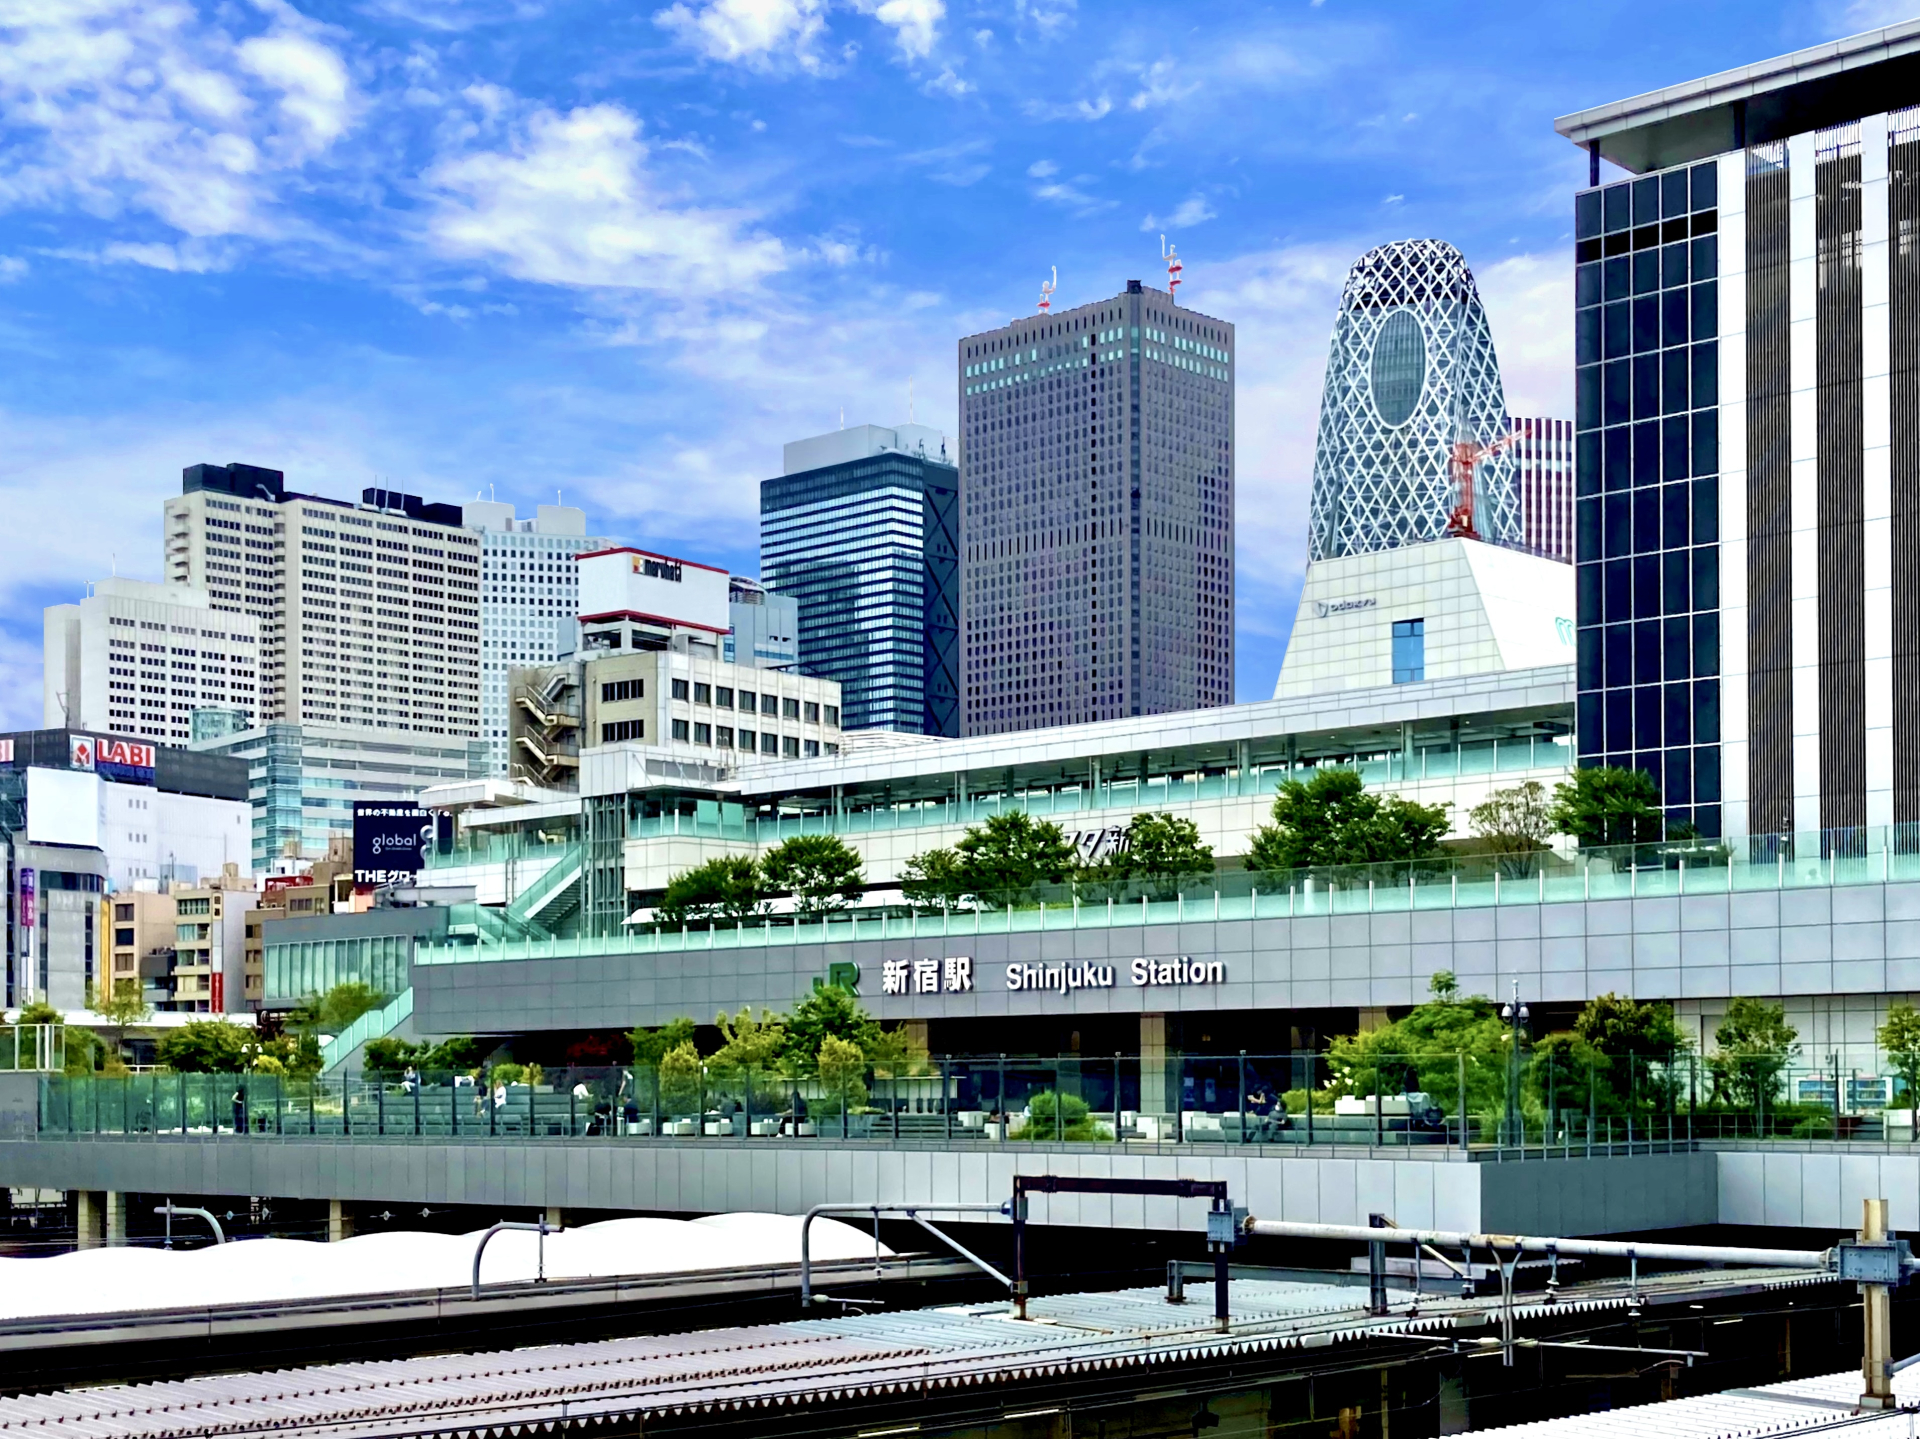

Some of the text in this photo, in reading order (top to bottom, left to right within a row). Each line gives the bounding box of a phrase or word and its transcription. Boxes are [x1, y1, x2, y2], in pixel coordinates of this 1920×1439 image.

[97, 739, 156, 767] LABI
[372, 833, 417, 854] global
[813, 956, 1224, 998] JR 新宿駅 Shinjuku Station
